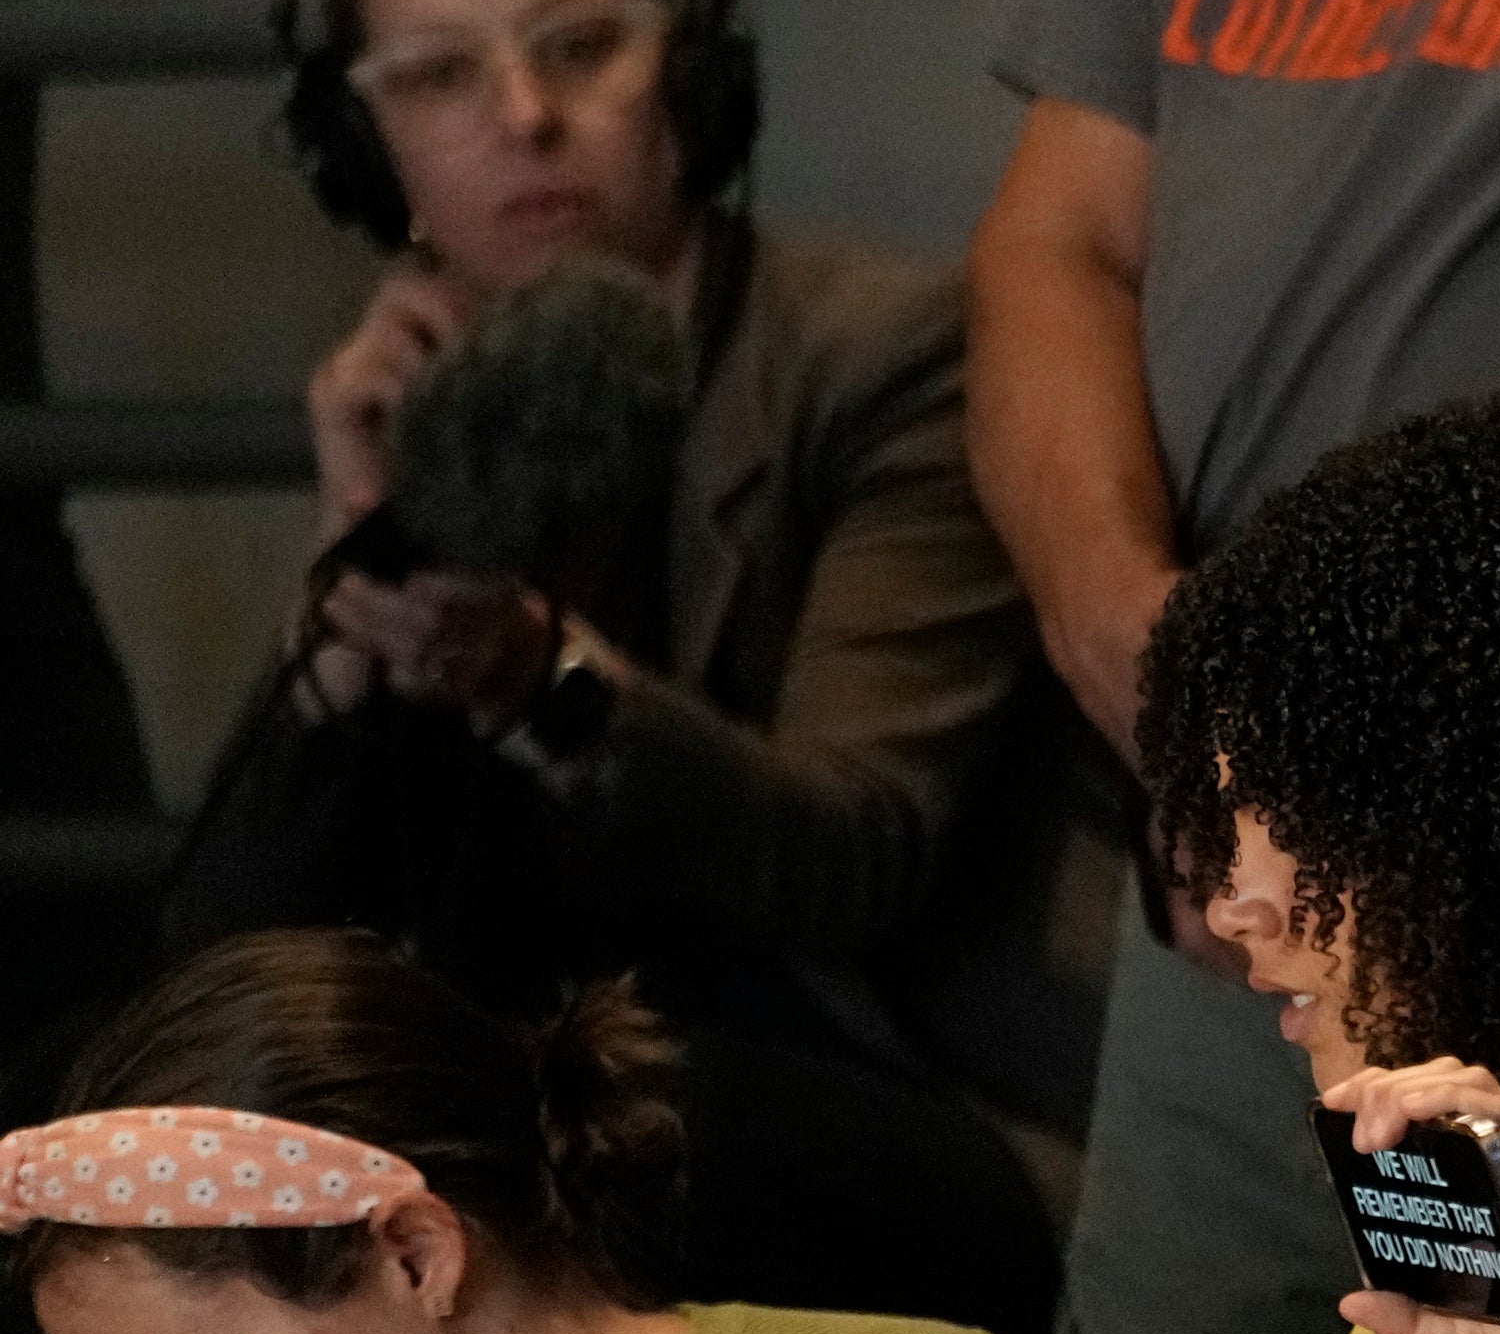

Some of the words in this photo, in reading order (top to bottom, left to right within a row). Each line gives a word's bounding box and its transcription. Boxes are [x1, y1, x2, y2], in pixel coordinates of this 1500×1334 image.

[1372, 1150, 1405, 1180] WE
[1400, 1153, 1448, 1187] WILL
[1352, 1186, 1452, 1230] REMEMBER
[1448, 1203, 1495, 1237] THAT
[1362, 1229, 1404, 1263] YOU
[1403, 1236, 1437, 1268] DID
